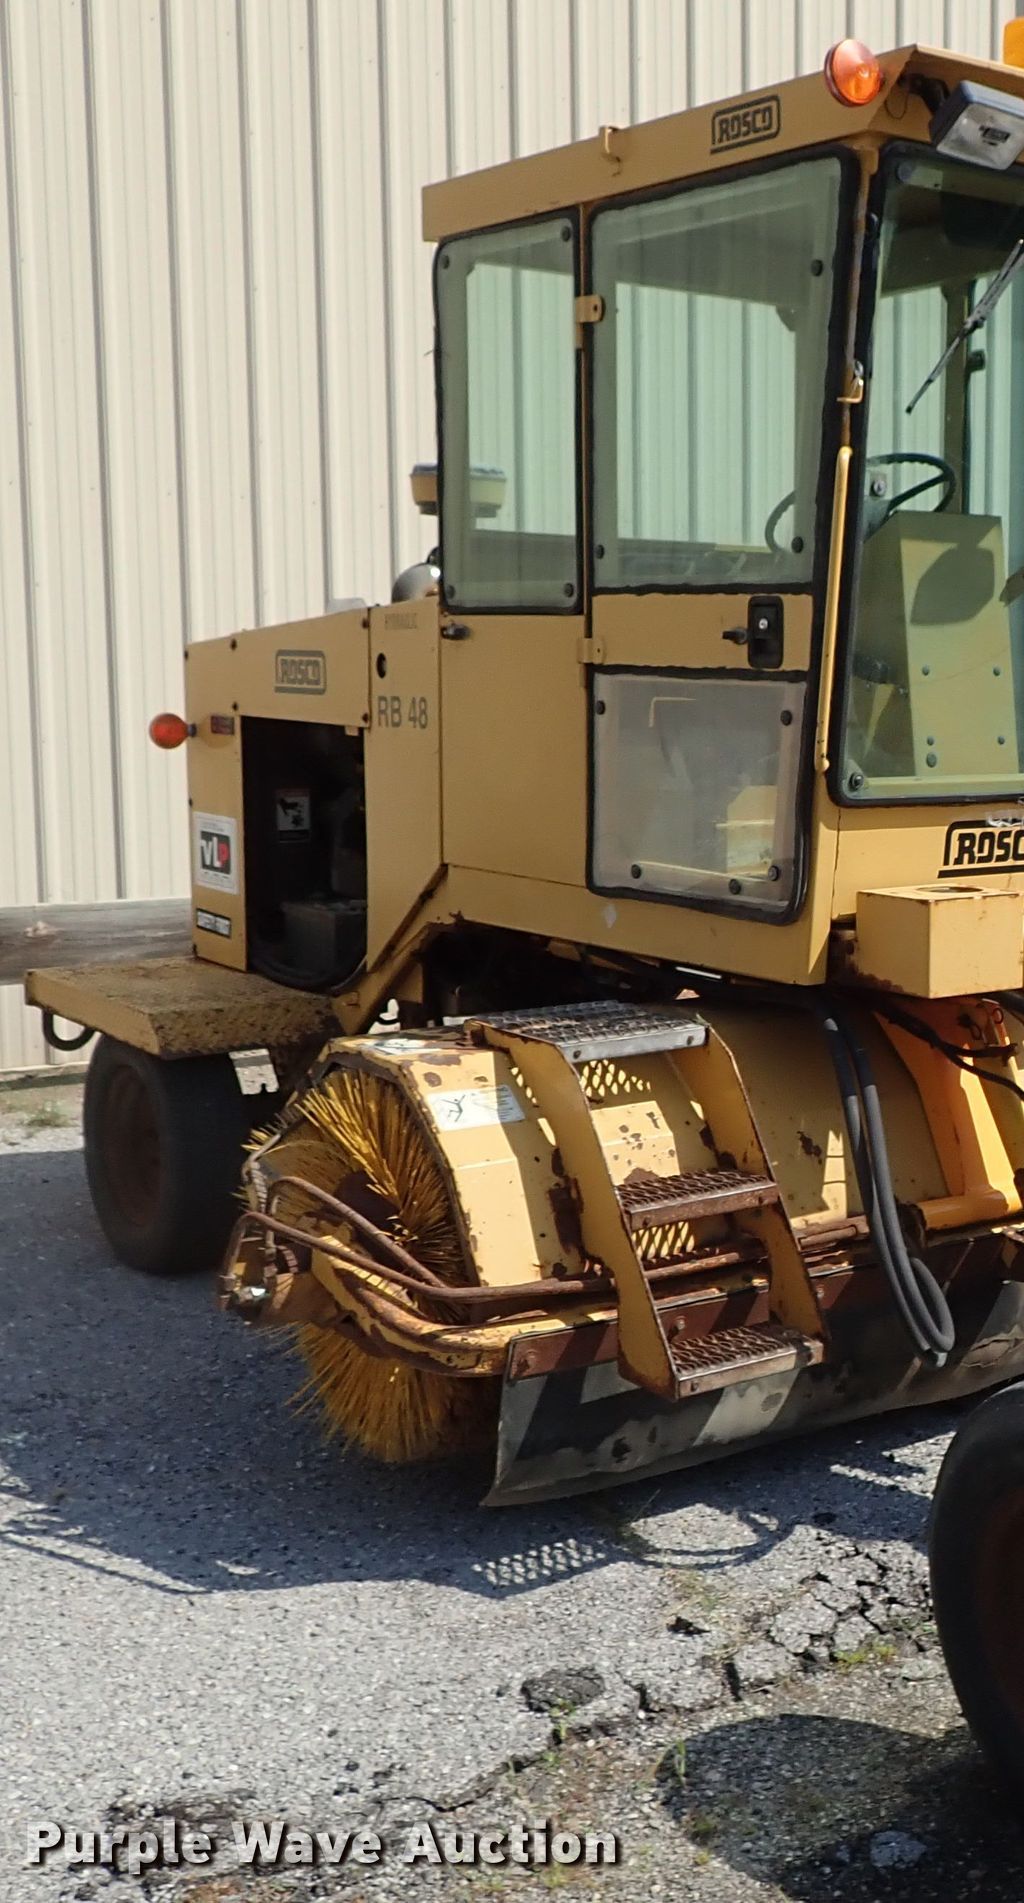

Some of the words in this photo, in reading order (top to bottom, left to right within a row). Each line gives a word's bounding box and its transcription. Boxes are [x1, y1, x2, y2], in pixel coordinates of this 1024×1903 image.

[717, 105, 773, 144] ROSCO
[280, 658, 321, 686] ROSCO
[377, 695, 402, 728] RB
[408, 696, 428, 730] 48
